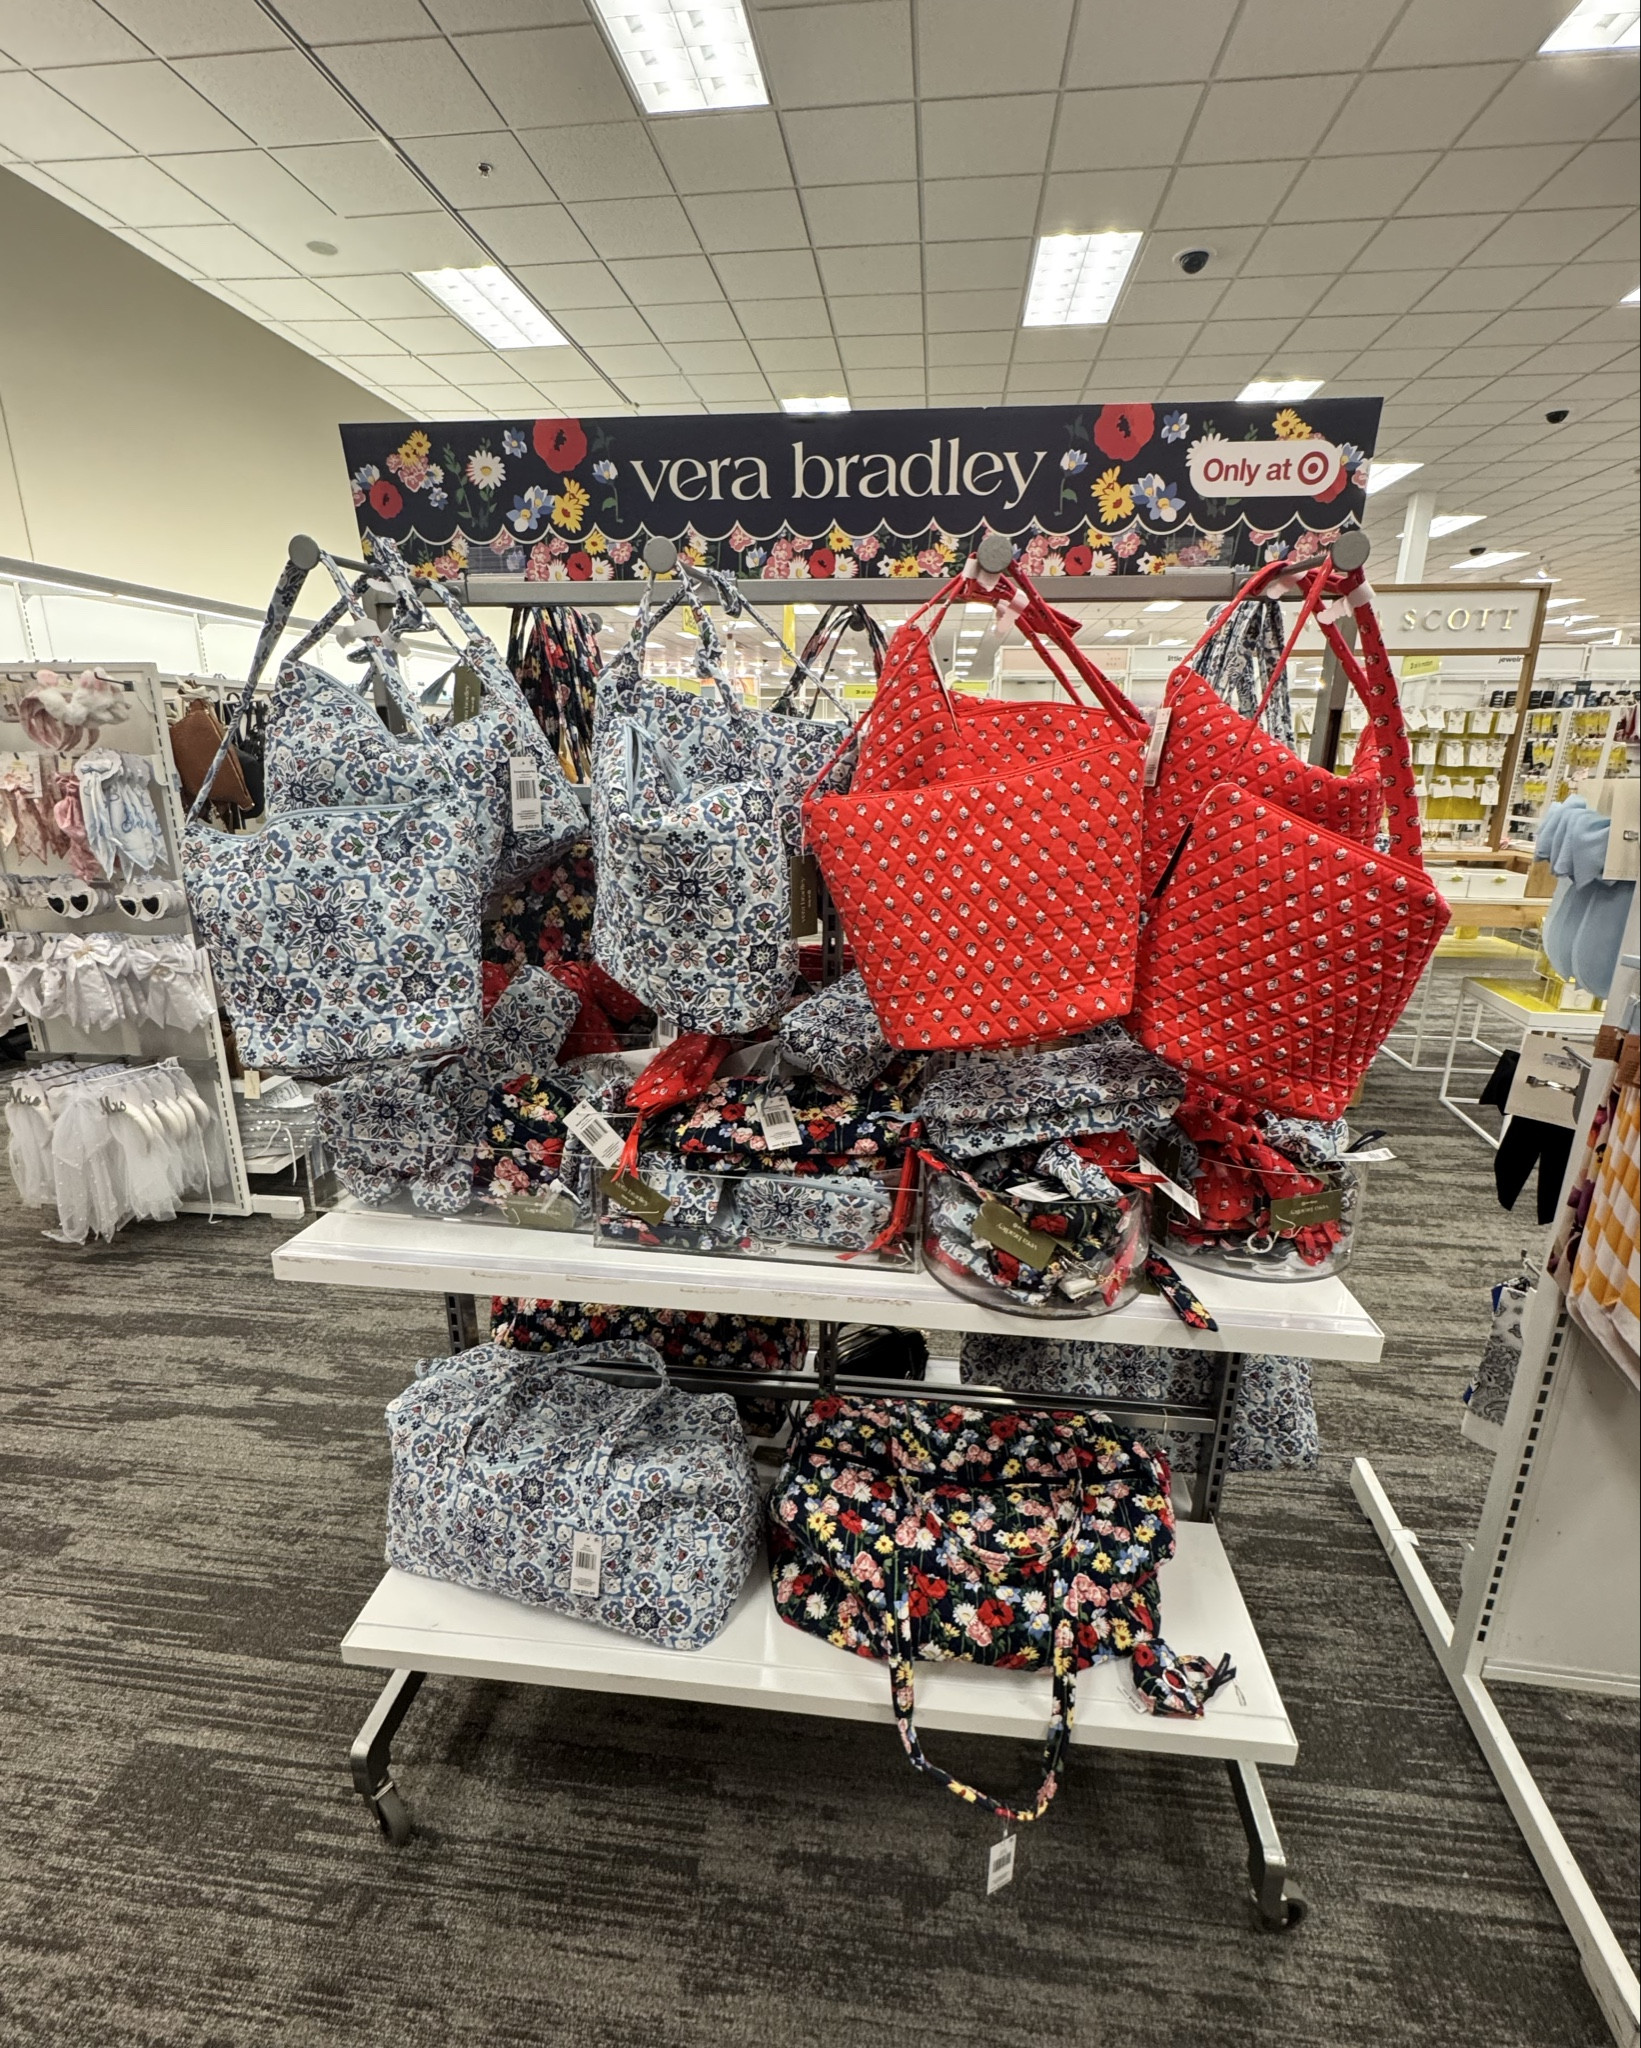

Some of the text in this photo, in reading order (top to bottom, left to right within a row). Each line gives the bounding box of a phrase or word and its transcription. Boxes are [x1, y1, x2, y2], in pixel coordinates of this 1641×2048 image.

[629, 437, 1048, 510] vera bradley
[1203, 458, 1292, 486] Only at
[1400, 608, 1519, 632] SCOTT
[1498, 656, 1522, 664] jewelr
